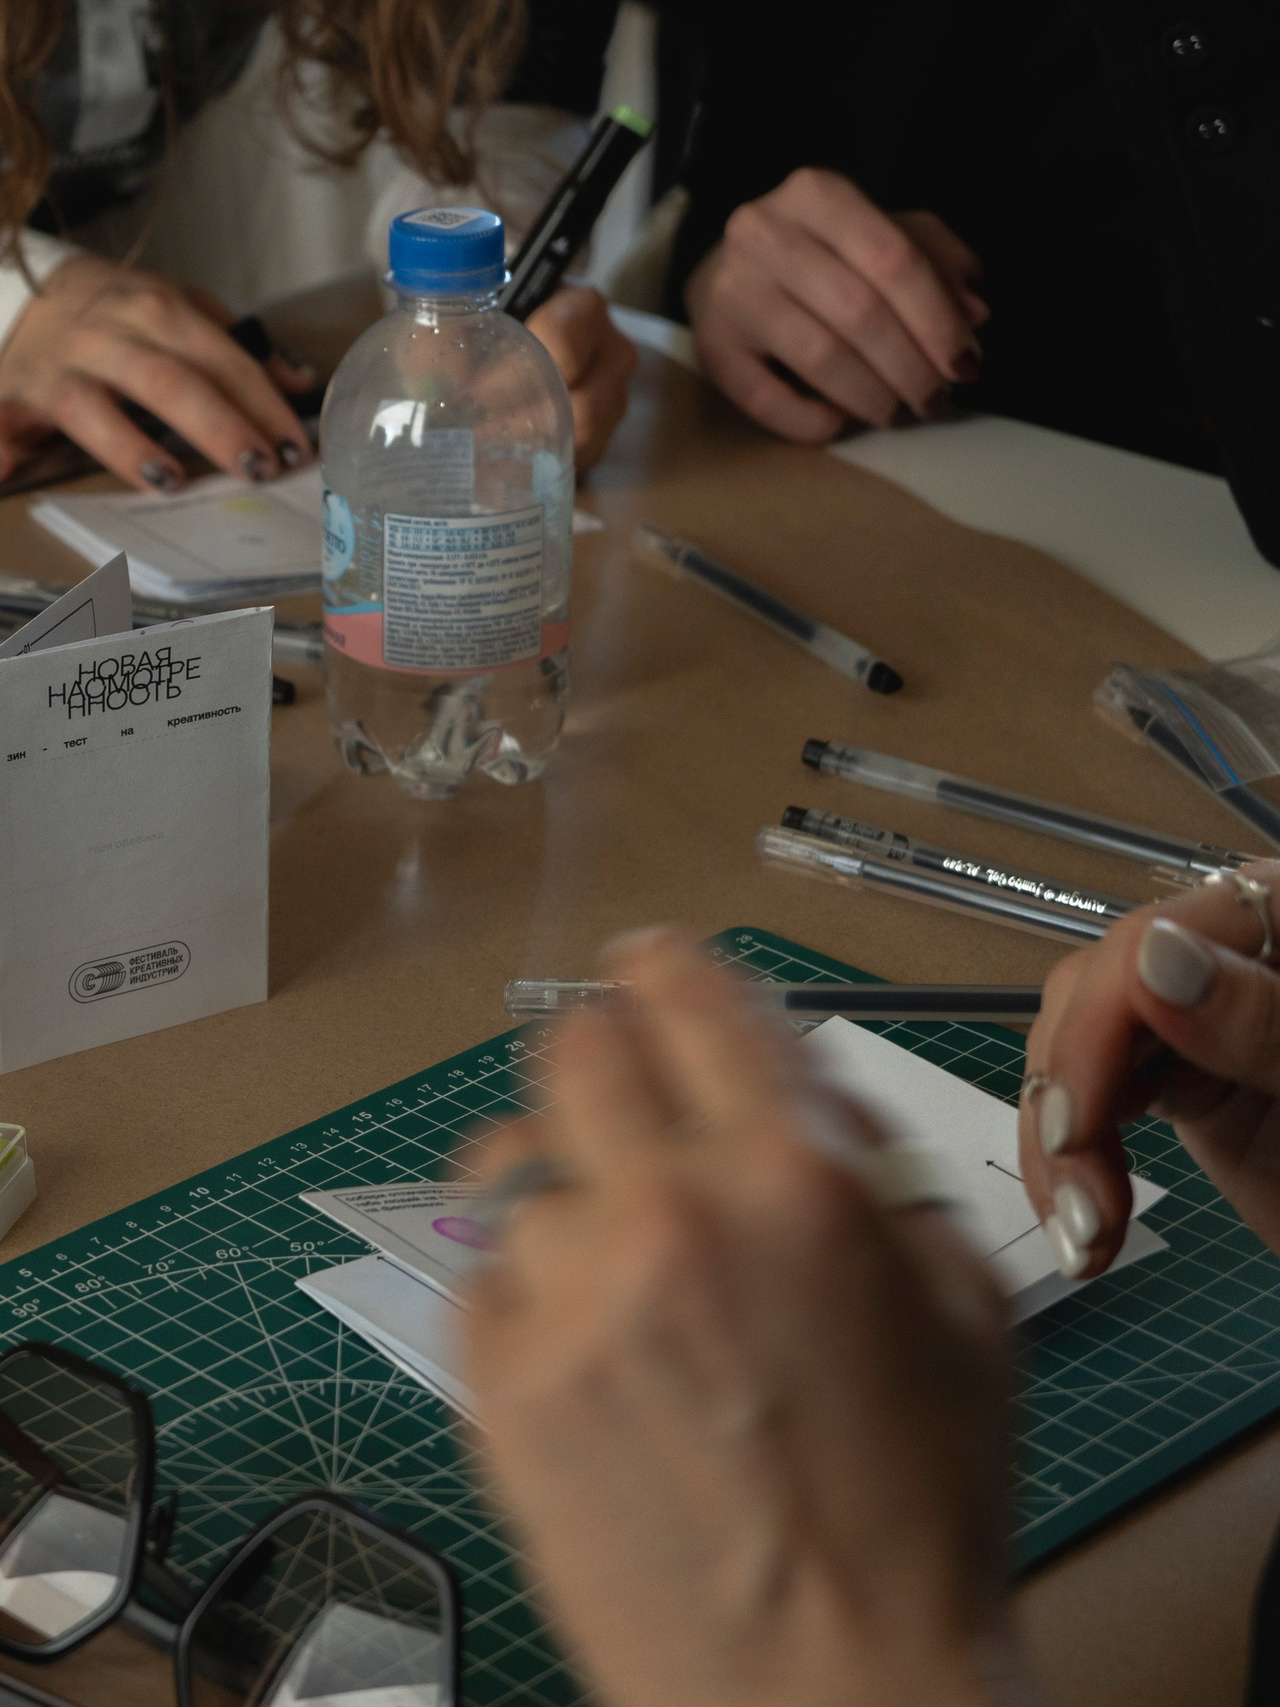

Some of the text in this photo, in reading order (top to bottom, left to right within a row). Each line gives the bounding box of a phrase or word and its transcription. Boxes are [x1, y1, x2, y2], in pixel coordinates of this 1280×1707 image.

[78, 647, 171, 684] НОВАЯ
[7, 751, 26, 762] зин
[63, 737, 88, 749] тест
[120, 727, 134, 738] на
[167, 705, 242, 728] креативность
[129, 947, 179, 966] ФЕСТИВАЛЬ
[129, 954, 184, 976] КРЕАТИВНЫХ
[129, 964, 179, 985] ИНДУСТРИЙ
[505, 1040, 526, 1052] 20
[478, 1055, 495, 1066] 19
[448, 1069, 465, 1080] 18
[417, 1083, 433, 1094] 17
[386, 1097, 403, 1109] 16
[351, 1111, 373, 1123] 15
[322, 1127, 339, 1138] 14
[290, 1142, 308, 1153] 13
[257, 1157, 276, 1168] 12
[225, 1173, 242, 1183] 11
[188, 1187, 210, 1199] 10
[160, 1205, 172, 1214] 9
[125, 1220, 138, 1229] 8
[90, 1236, 101, 1245] 7
[56, 1253, 68, 1262] 6
[18, 1268, 33, 1279] 5
